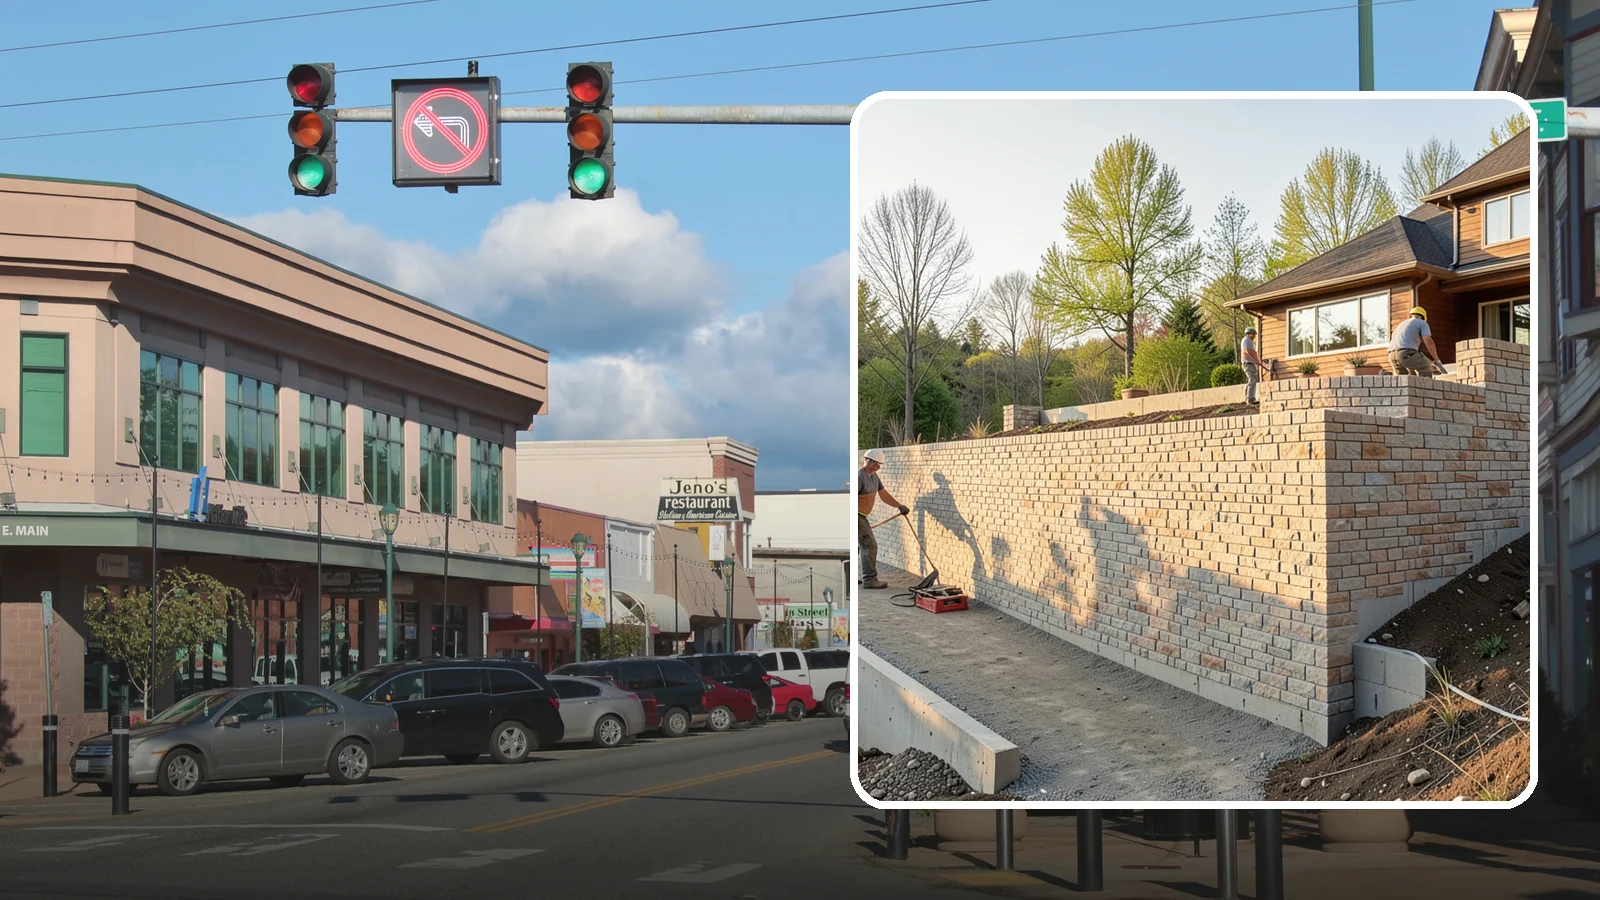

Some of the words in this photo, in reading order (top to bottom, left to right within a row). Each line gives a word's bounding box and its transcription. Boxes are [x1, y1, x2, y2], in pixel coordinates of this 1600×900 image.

[669, 480, 728, 495] Jeno's
[665, 496, 731, 509] restaurant
[658, 509, 681, 520] Italian
[685, 509, 714, 519] American
[714, 509, 738, 519] Cuisine
[2, 525, 13, 536] E.
[15, 525, 49, 536] MAIN
[785, 607, 795, 617] in
[797, 607, 828, 617] Street
[790, 619, 824, 627] lass
